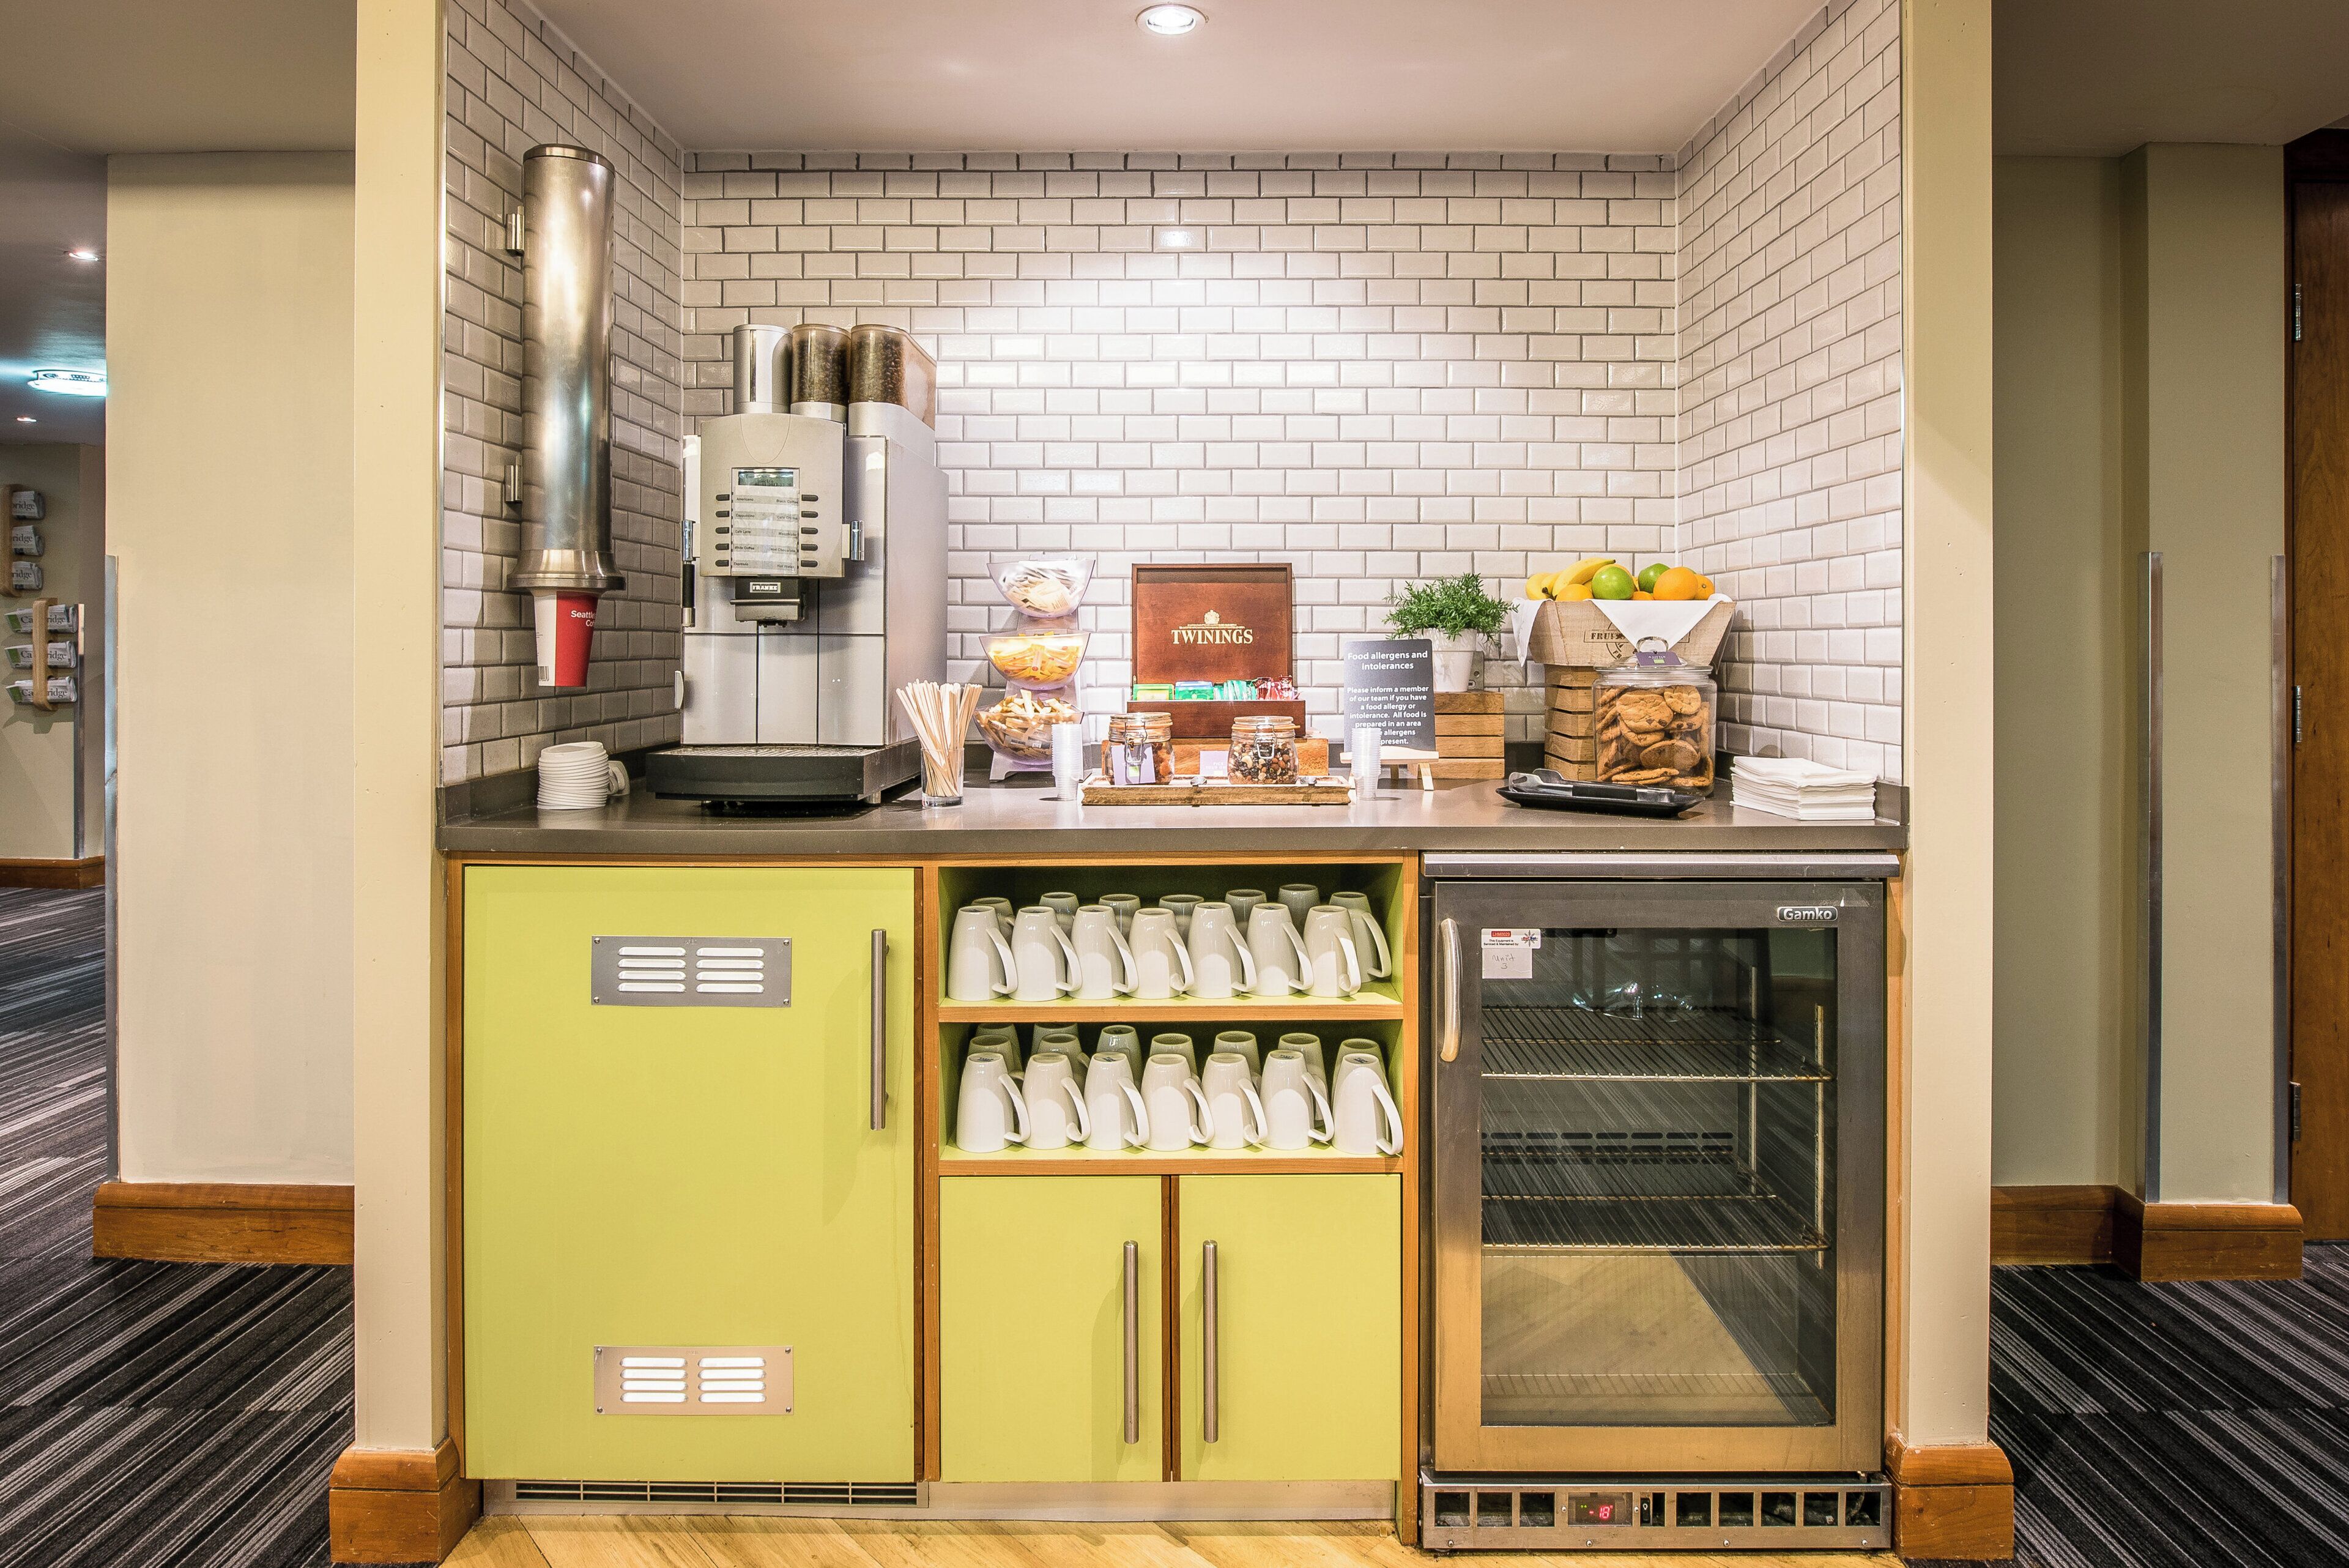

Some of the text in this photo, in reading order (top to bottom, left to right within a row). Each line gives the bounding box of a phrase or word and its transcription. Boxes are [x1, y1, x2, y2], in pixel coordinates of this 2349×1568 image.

[12, 533, 32, 544] ridge
[12, 570, 32, 580] ridge
[21, 615, 65, 624] Caridge
[1171, 629, 1253, 644] TWININGS
[21, 651, 67, 660] Caridge
[1371, 652, 1410, 661] allergens
[1411, 650, 1428, 659] and
[22, 689, 68, 699] Caridge
[1783, 907, 1833, 920] Gamko
